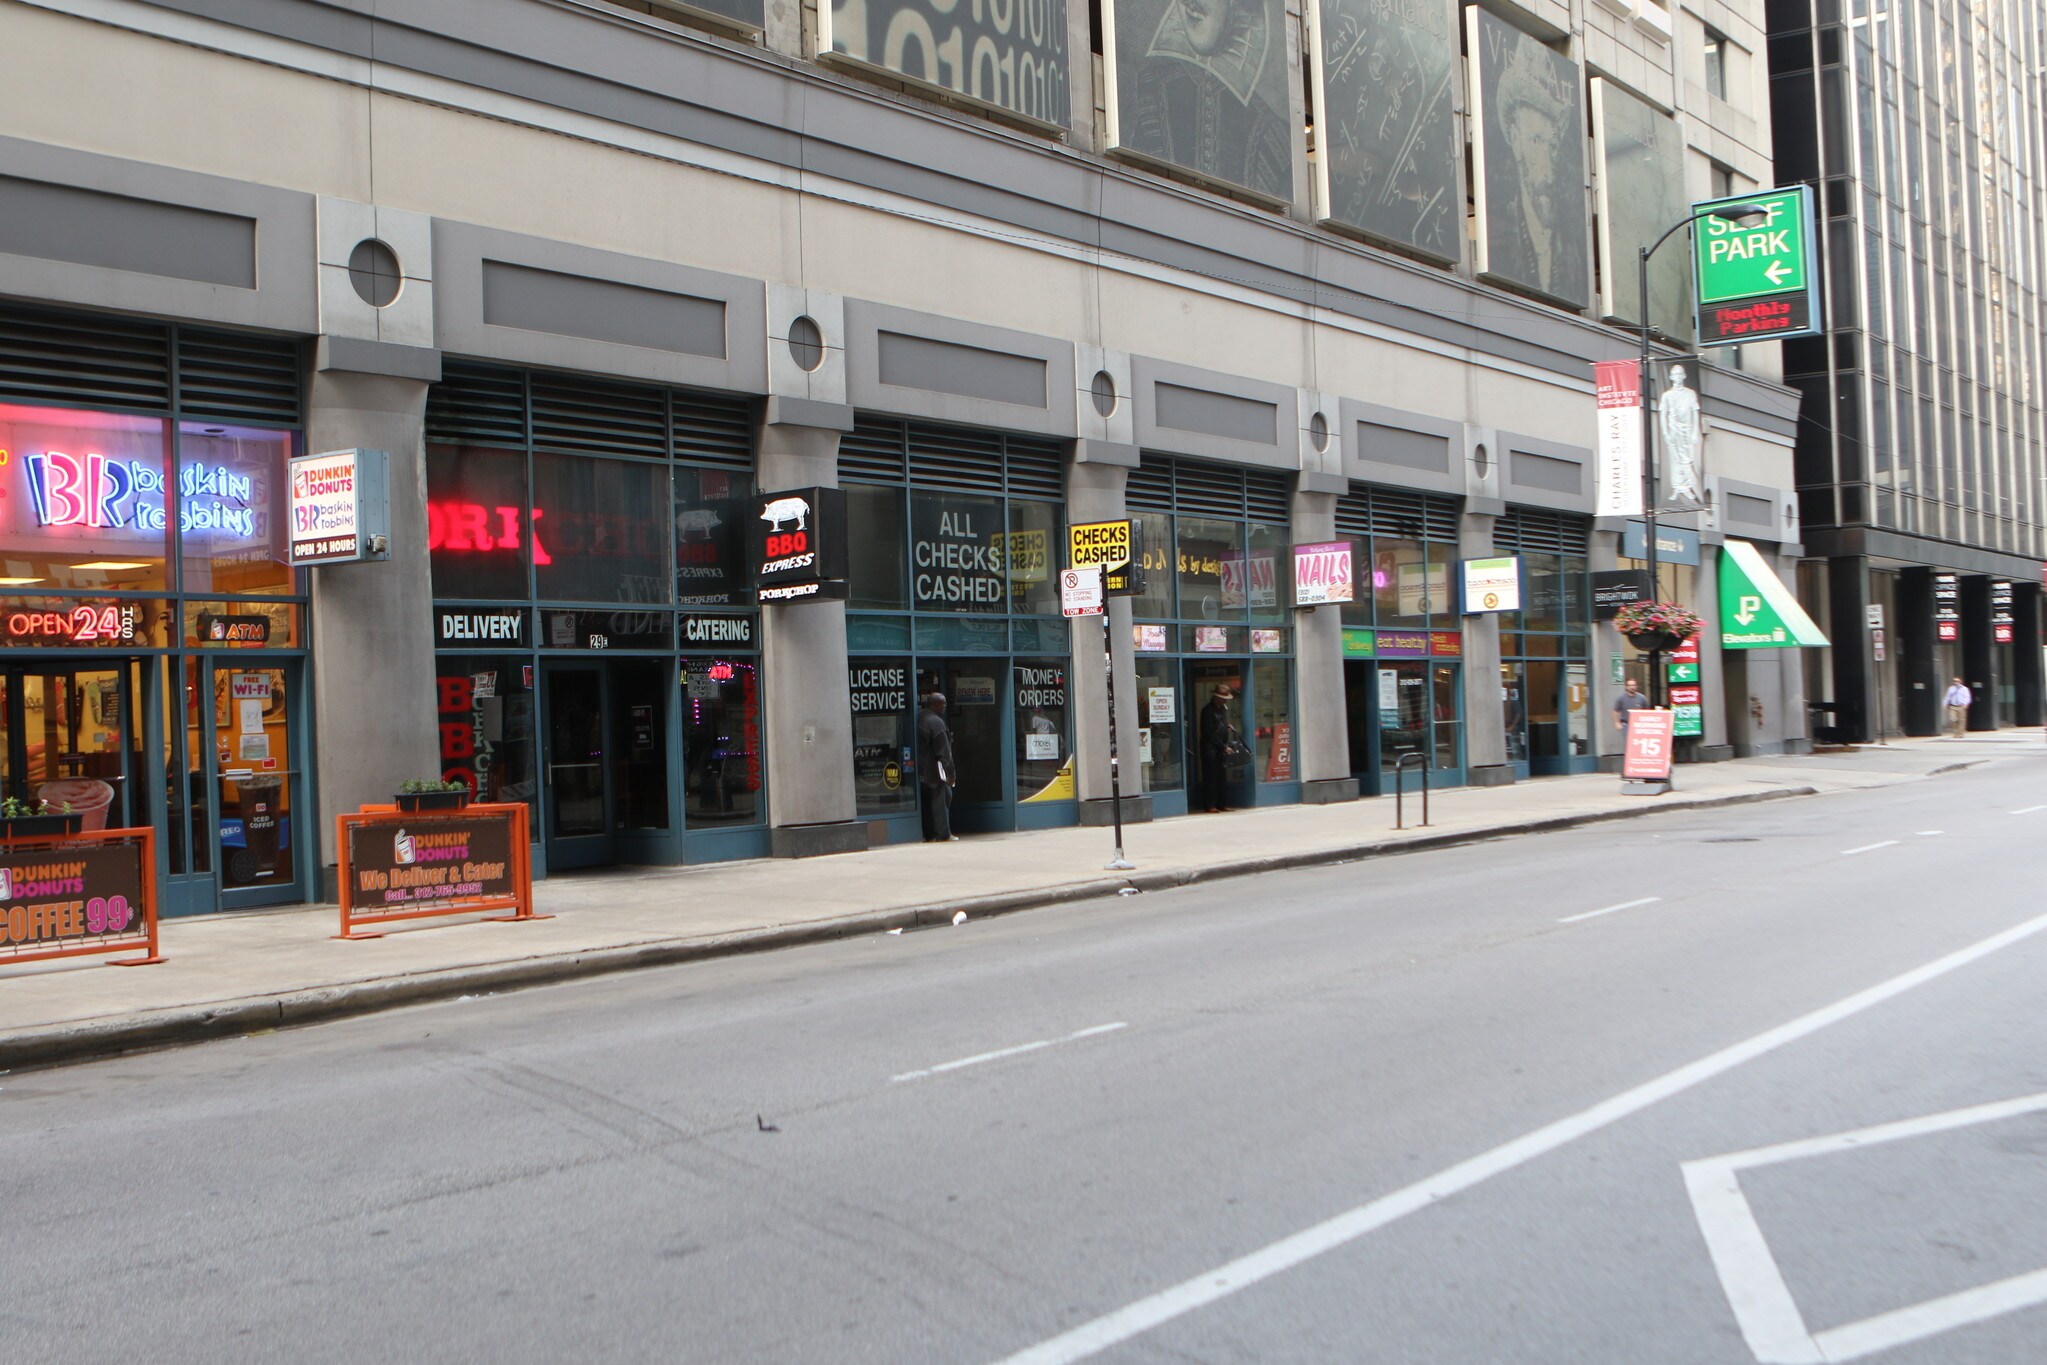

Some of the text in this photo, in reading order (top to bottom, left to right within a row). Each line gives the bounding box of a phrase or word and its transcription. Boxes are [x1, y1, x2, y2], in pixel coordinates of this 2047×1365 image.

[1708, 202, 1784, 236] SF
[1709, 229, 1791, 265] PARK
[1610, 414, 1622, 510] CHARLES RAY
[309, 463, 355, 483] DUNKIN'
[23, 450, 132, 528] BR
[309, 478, 353, 497] DONUTS
[320, 501, 353, 515] baskin
[294, 504, 320, 533] BR
[321, 515, 354, 530] robbins
[939, 511, 978, 539] ALL
[766, 531, 808, 558] BBQ
[1073, 526, 1127, 546] CHECKS
[294, 538, 356, 557] OPEN 24 HOURS
[915, 541, 1000, 572] CHECKS
[1074, 545, 1127, 564] CASHED
[762, 552, 815, 575] EXPRESS
[1298, 553, 1349, 586] NAILS
[759, 583, 819, 601] PORKCHOP
[916, 574, 1001, 602] CASHED
[9, 606, 134, 640] OPEN 24 HRS
[226, 623, 264, 640] ATM
[443, 615, 521, 640] DELIVERY
[687, 618, 750, 642] CATERING
[1377, 635, 1427, 654] eat healthy
[1722, 632, 1773, 644] Elevators
[709, 665, 733, 680] ATM
[850, 669, 905, 688] LICENSE
[1022, 669, 1061, 685] MONEY
[234, 684, 269, 696] WI-FI
[977, 686, 992, 695] HERE
[1019, 689, 1064, 707] ORDERS
[851, 692, 906, 711] SERVICE
[1631, 738, 1661, 756] $15
[250, 821, 275, 829] COFFEE
[415, 832, 471, 848] DUNKIN'
[415, 845, 470, 862] DONUTS
[11, 861, 88, 883] DUNKIN'
[360, 861, 506, 891] We Deliver & Cater
[12, 877, 84, 898] DONUTS
[414, 882, 483, 899] 312-765-9952
